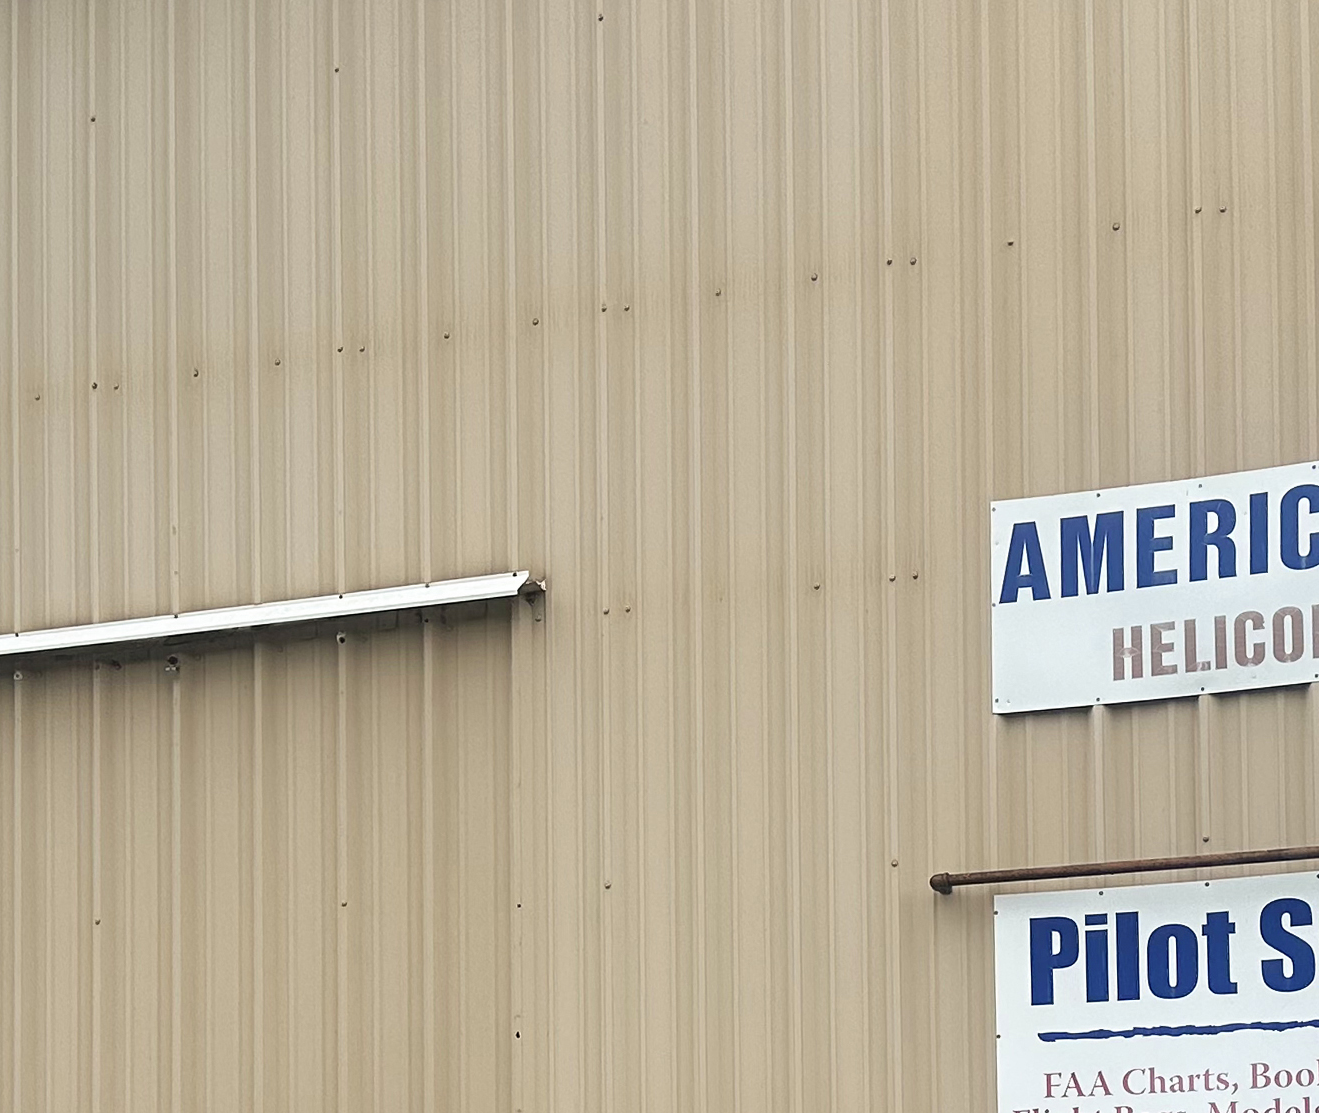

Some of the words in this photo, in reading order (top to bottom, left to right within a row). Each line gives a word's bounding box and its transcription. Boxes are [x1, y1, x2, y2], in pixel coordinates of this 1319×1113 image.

[1028, 910, 1239, 1007] Pilot
[1042, 1070, 1115, 1100] FAA
[1121, 1065, 1240, 1096] Charts,
